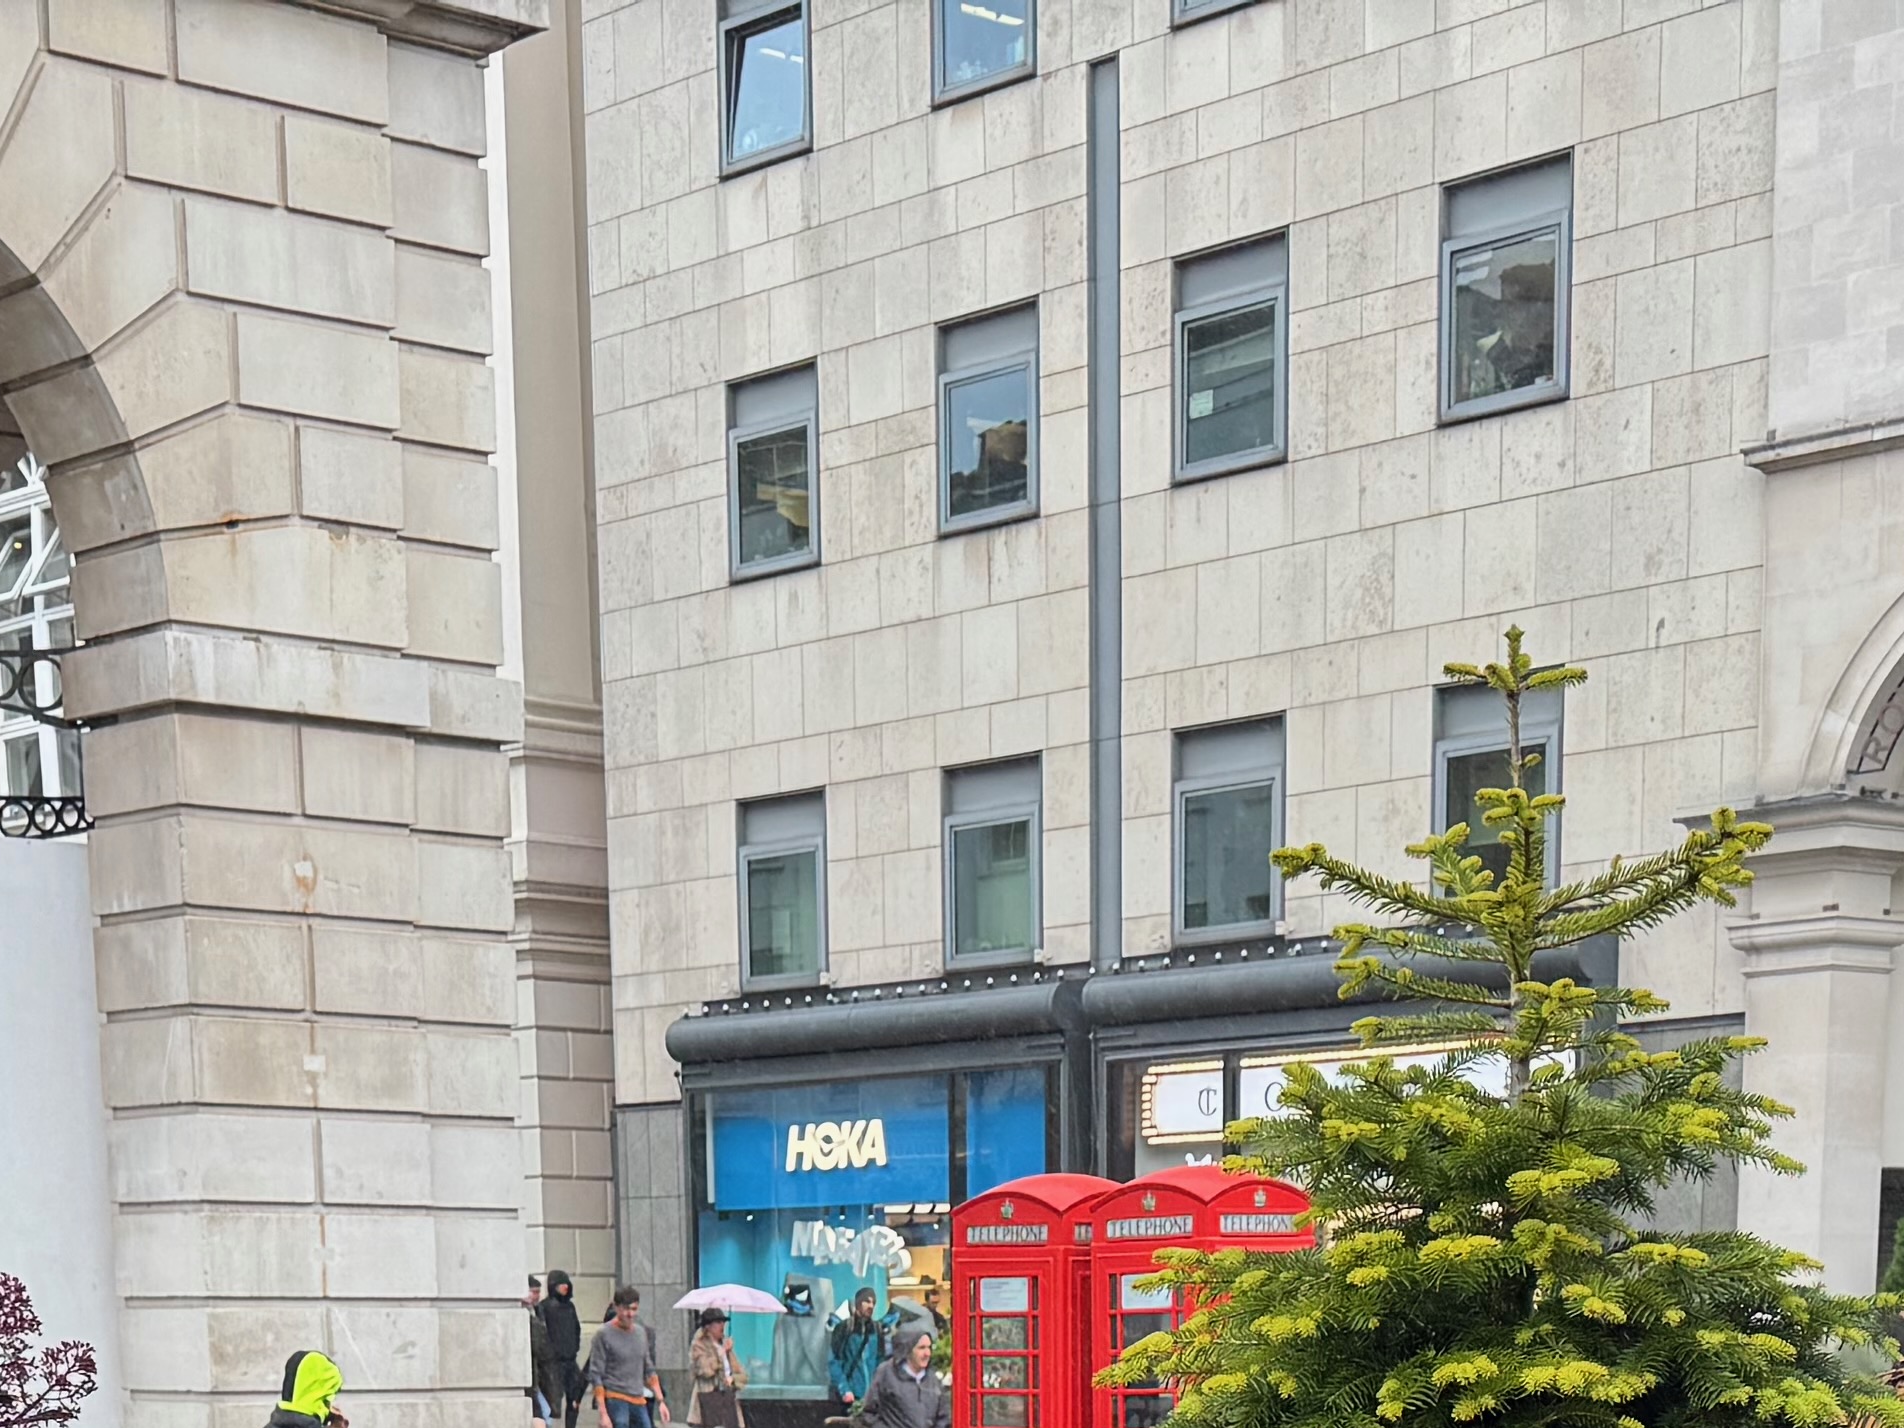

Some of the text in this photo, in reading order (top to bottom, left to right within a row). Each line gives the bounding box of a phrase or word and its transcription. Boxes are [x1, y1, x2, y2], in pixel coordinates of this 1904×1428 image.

[785, 1118, 887, 1172] HOKA
[1111, 1216, 1191, 1237] TELEPHONE
[1222, 1213, 1294, 1233] TELEPHON
[969, 1226, 1045, 1245] TELEPHONE
